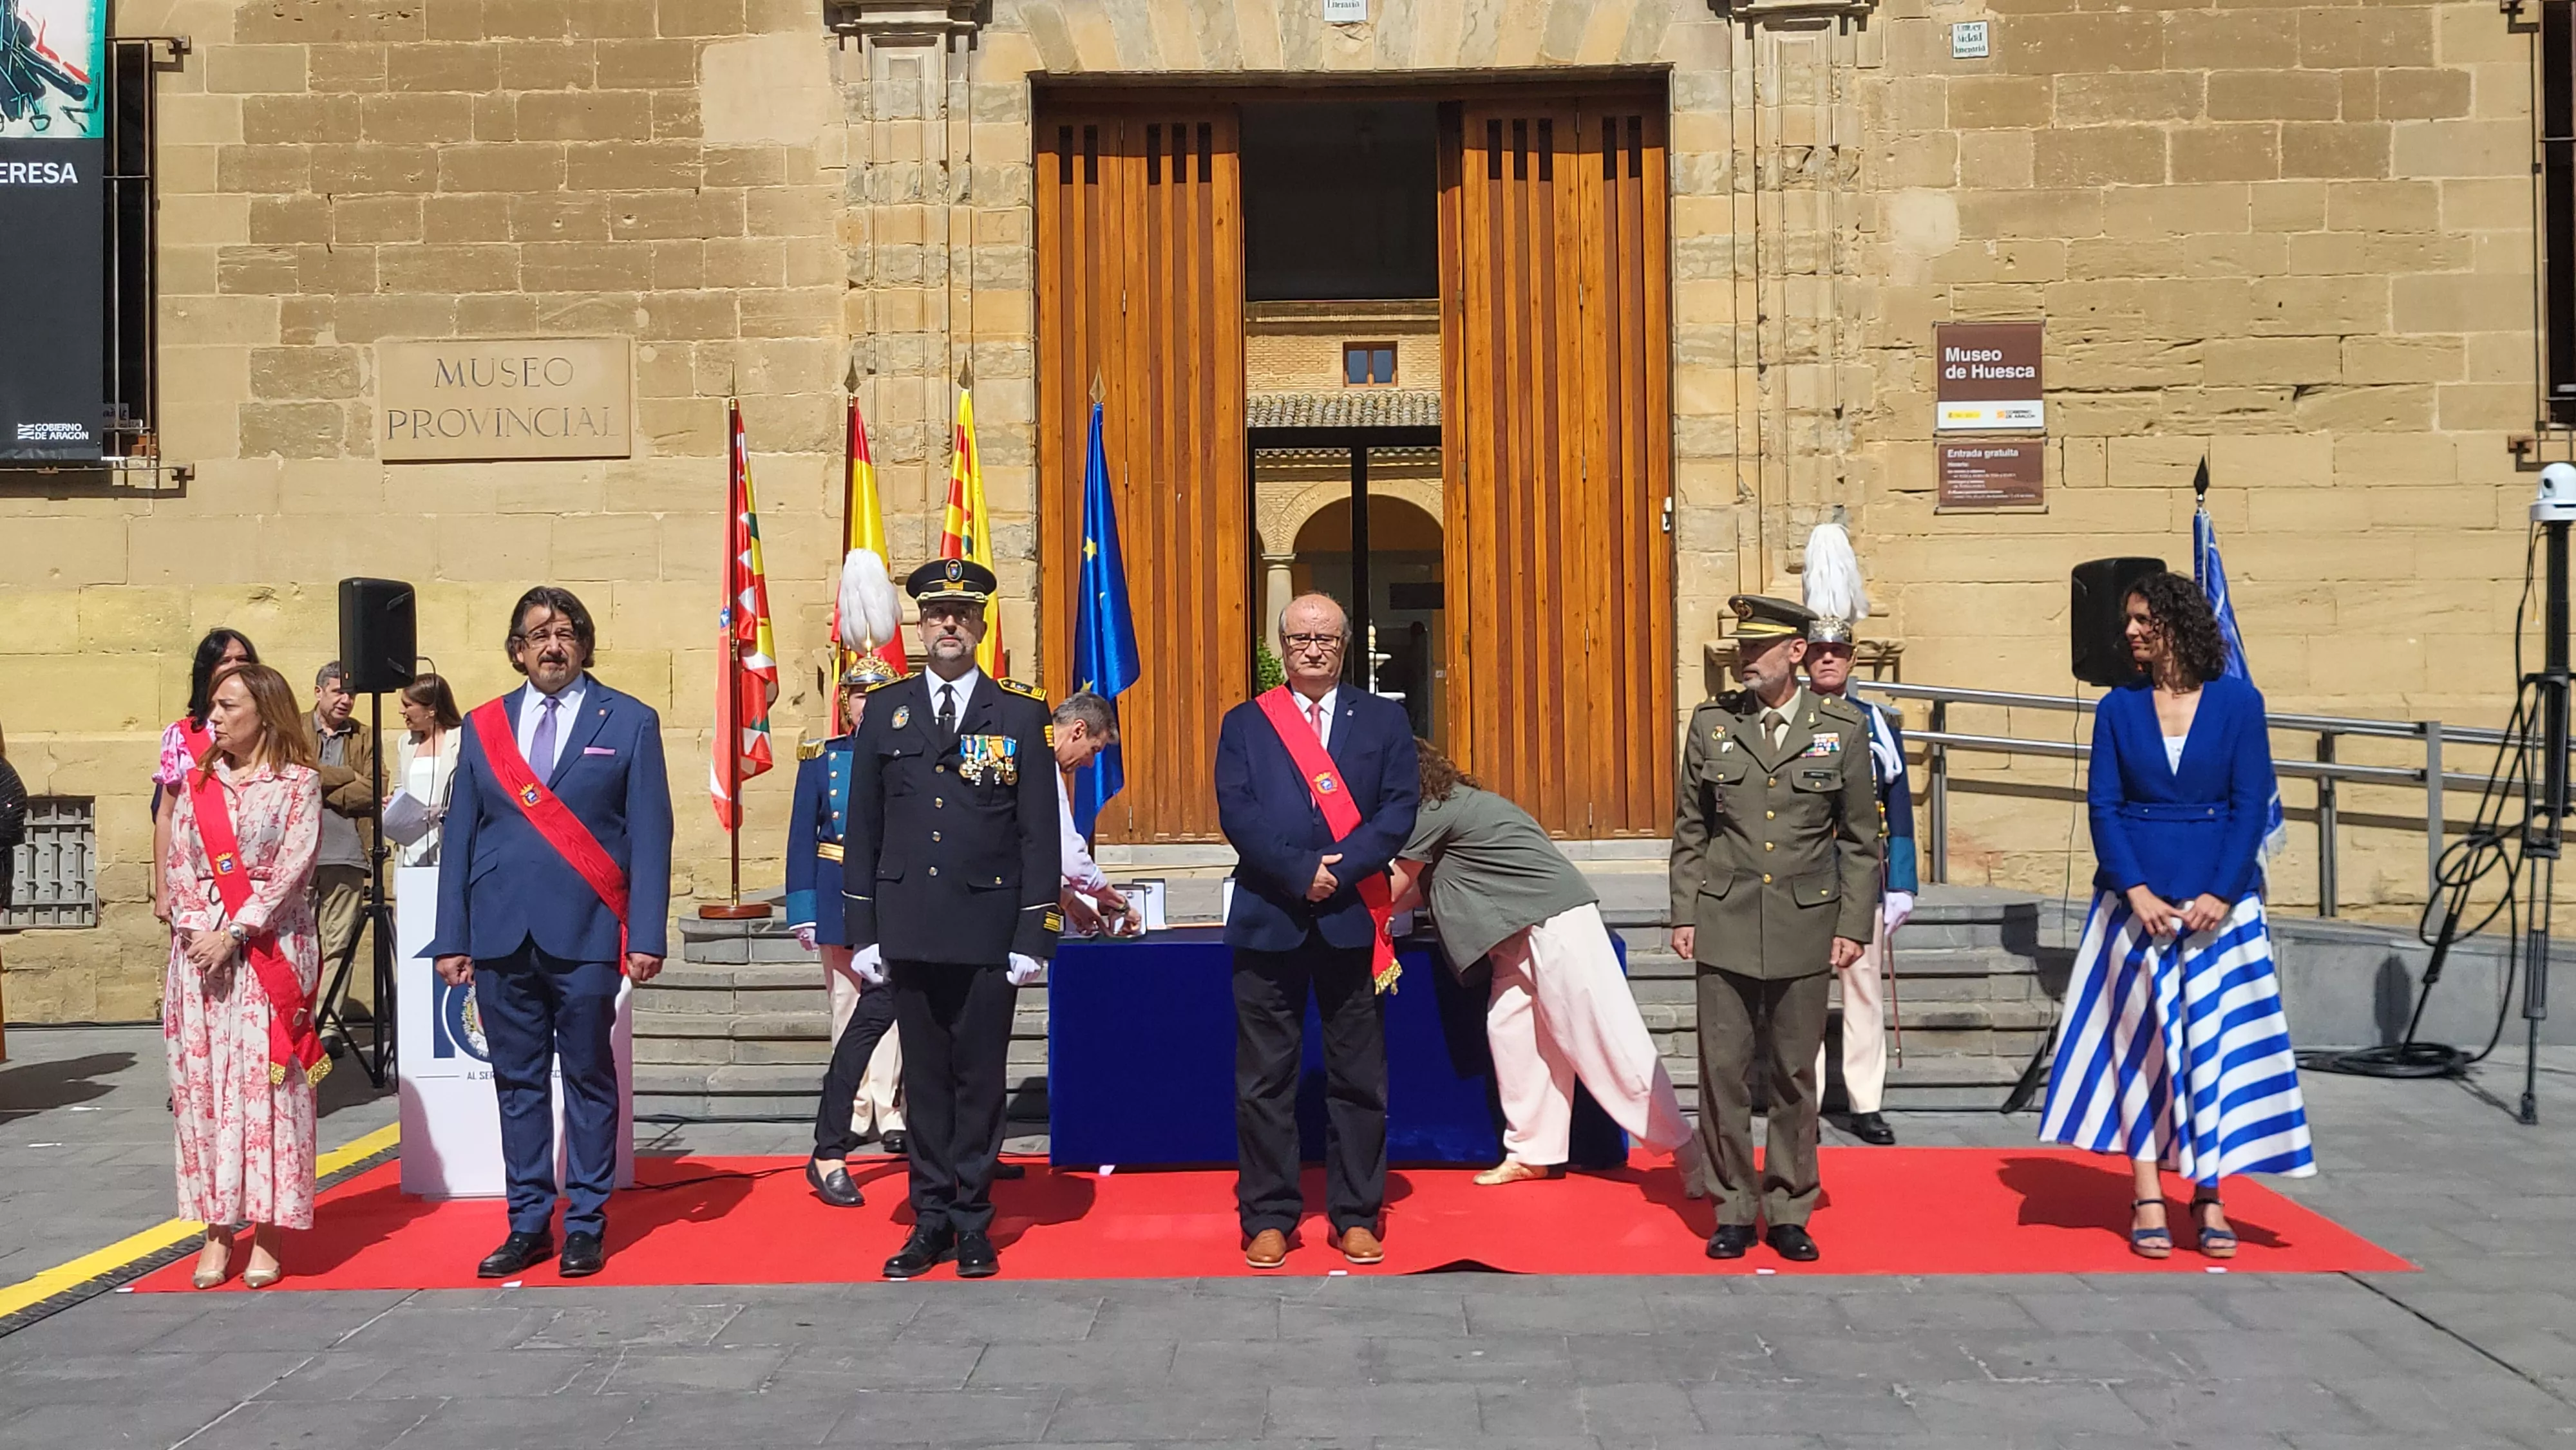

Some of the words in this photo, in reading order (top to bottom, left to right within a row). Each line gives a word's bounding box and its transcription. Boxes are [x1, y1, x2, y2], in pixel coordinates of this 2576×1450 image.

[0, 162, 79, 184] ERESA
[1946, 347, 2002, 362] Museo
[433, 357, 574, 388] MUSEO
[1945, 364, 1967, 379] de
[1971, 364, 2035, 379] Huesca
[35, 423, 82, 431] GOBIERNO
[386, 407, 620, 440] PROVINCIAL
[35, 431, 47, 440] DE
[49, 431, 89, 440] ARAGON
[1947, 449, 1983, 458] Entrada
[1984, 448, 2019, 459] gratuita
[466, 1071, 478, 1080] AL
